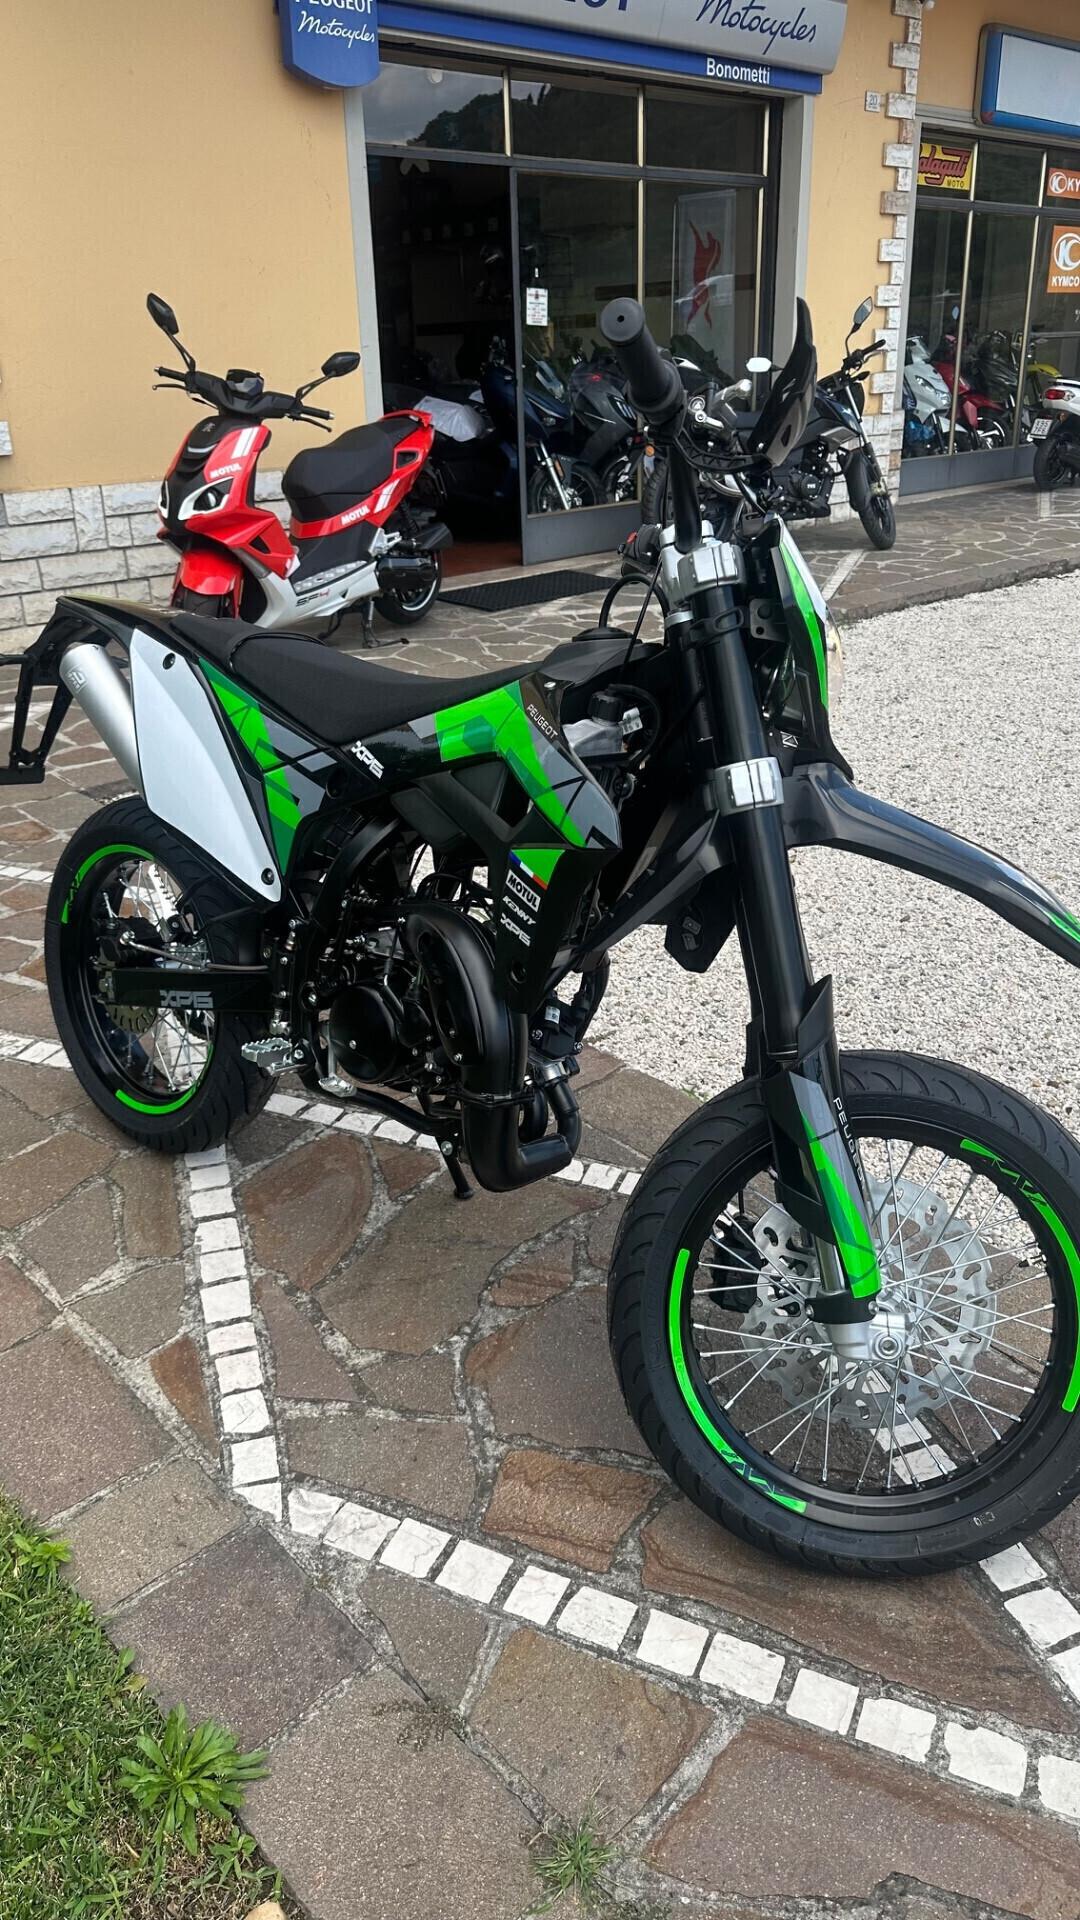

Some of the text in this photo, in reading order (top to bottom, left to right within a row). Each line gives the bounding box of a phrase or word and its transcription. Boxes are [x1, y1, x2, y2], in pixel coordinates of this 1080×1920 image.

[298, 11, 375, 48] Motocycles
[697, 0, 816, 55] Motocycles
[706, 57, 770, 84] Bonometti
[918, 143, 971, 185] alaguti
[1051, 275, 1080, 288] KYMCO
[209, 463, 241, 478] MOTUL
[341, 505, 370, 526] MOTUL
[526, 704, 558, 739] PEUGEOT
[507, 872, 539, 909] MOTUL
[502, 895, 536, 925] KENNY
